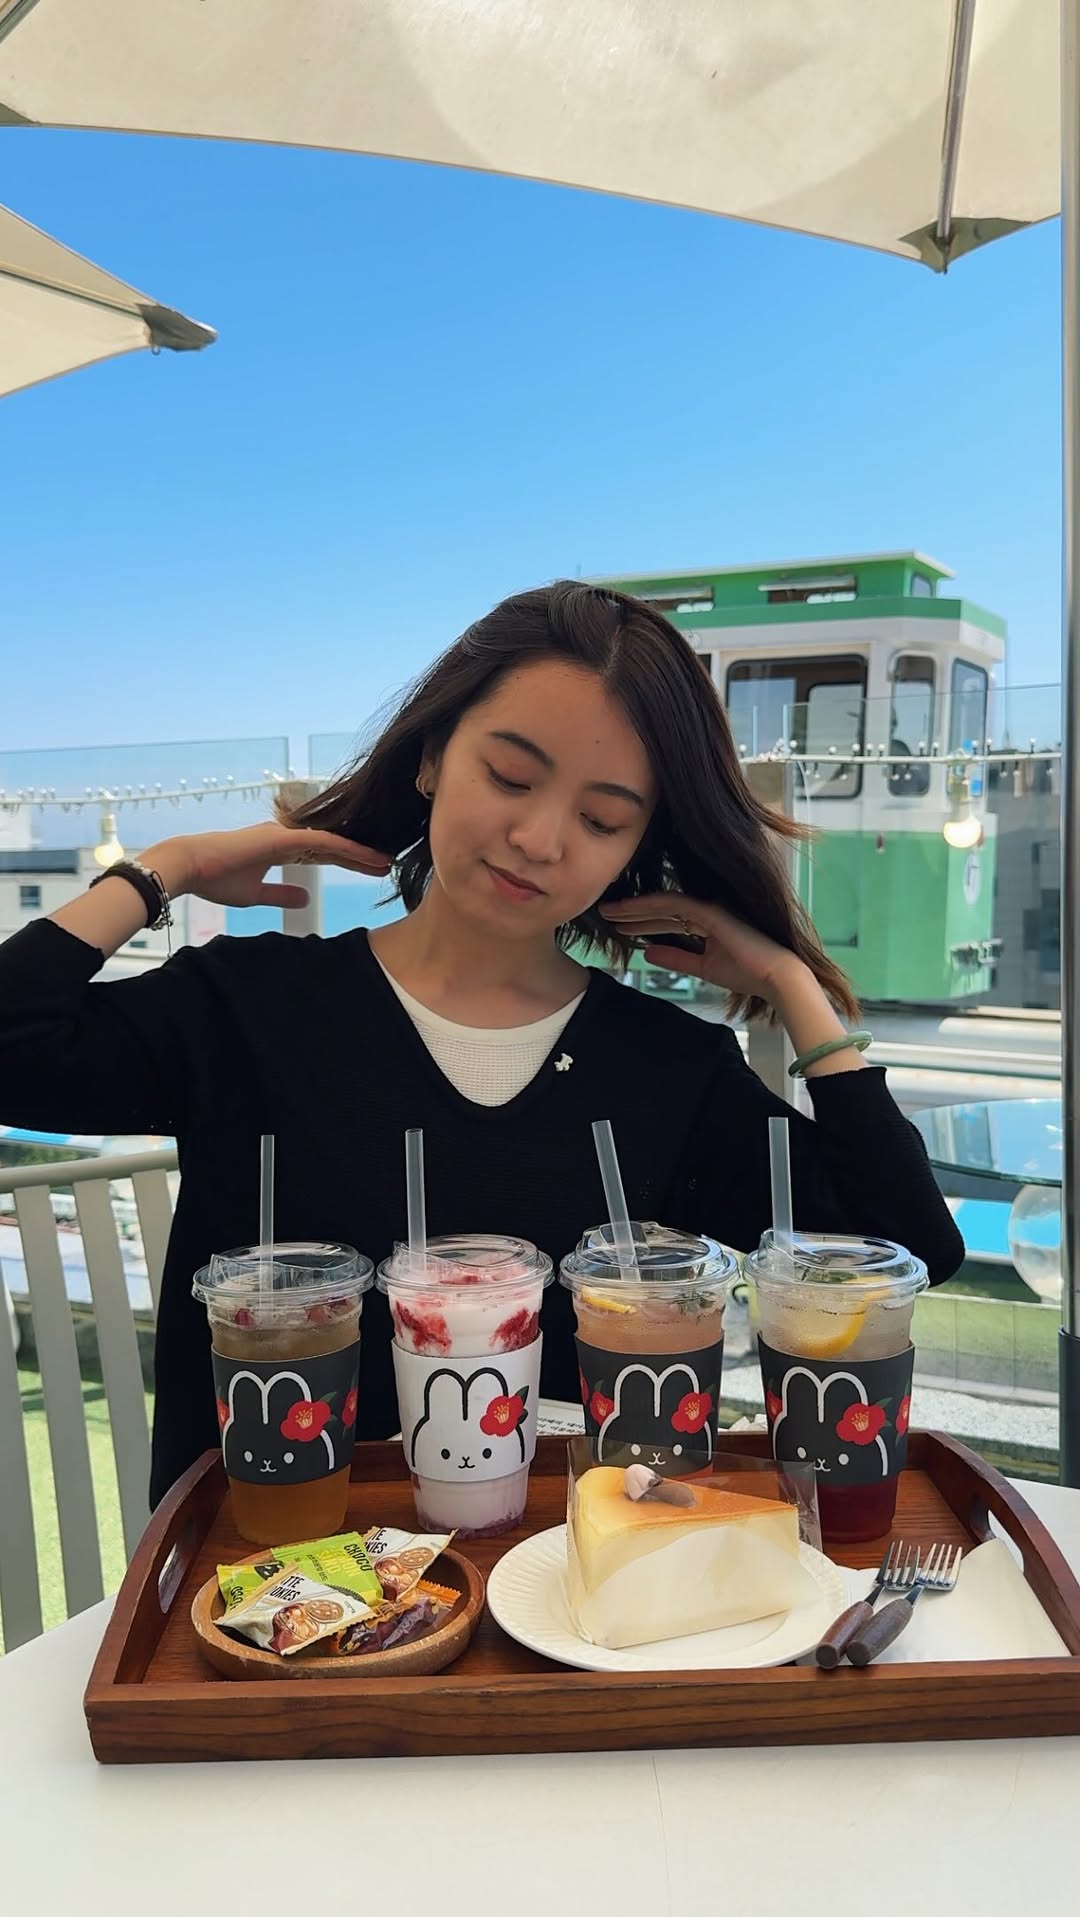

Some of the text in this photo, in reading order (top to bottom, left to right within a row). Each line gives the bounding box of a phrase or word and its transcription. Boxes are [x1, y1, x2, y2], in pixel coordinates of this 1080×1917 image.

[343, 1543, 373, 1572] CHOCO
[281, 1575, 305, 1588] TTE
[269, 1586, 301, 1601] OKIES
